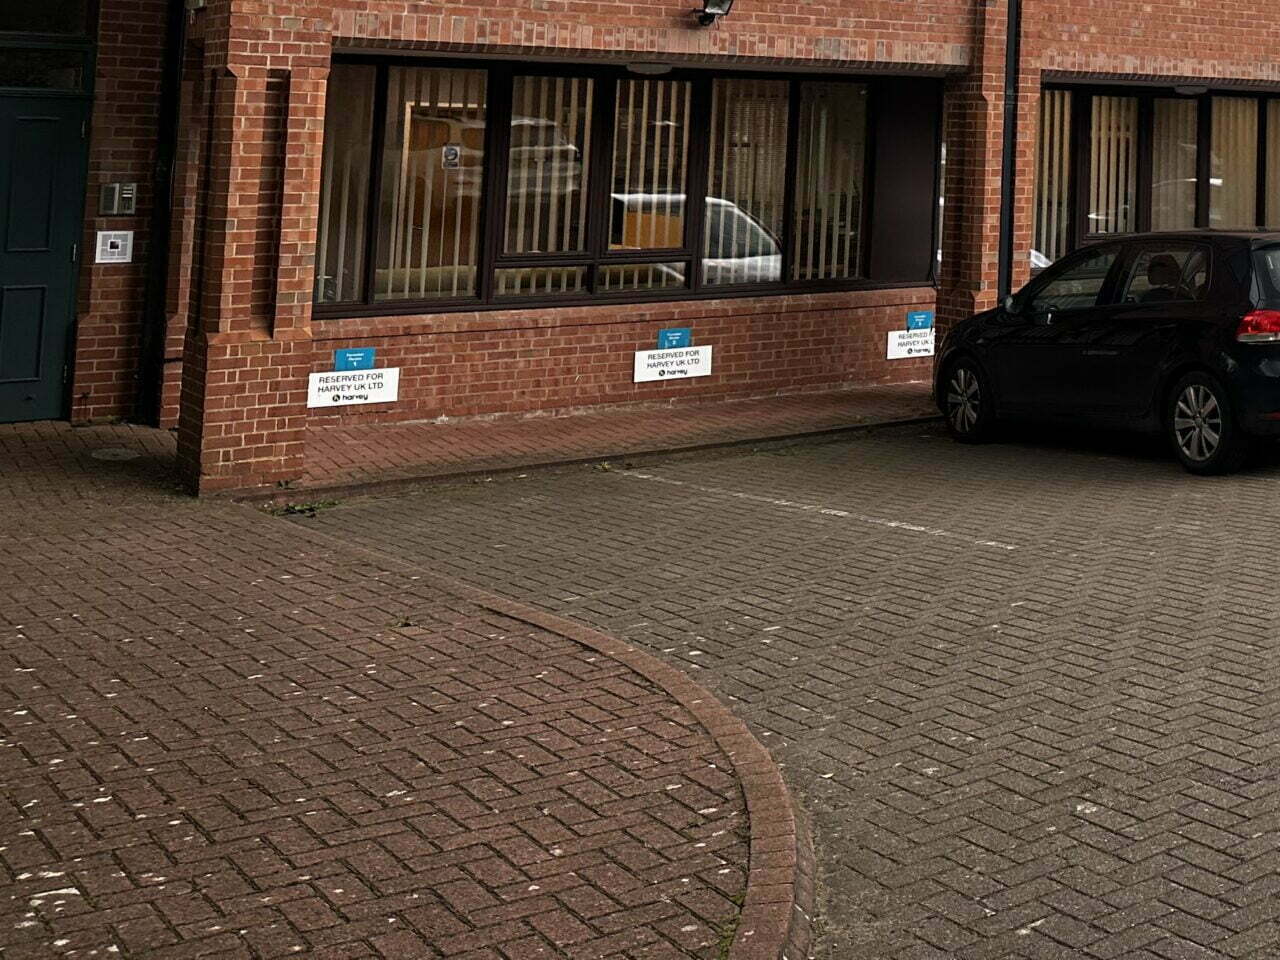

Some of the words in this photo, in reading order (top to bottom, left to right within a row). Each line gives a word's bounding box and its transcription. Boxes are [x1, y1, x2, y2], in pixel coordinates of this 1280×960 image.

[648, 352, 684, 360] RESERVED
[647, 361, 674, 369] HARVEY
[319, 374, 364, 384] RESERVED
[366, 372, 384, 380] FOR
[318, 384, 352, 393] HARVEY
[354, 383, 366, 391] UK
[368, 382, 384, 390] LTD
